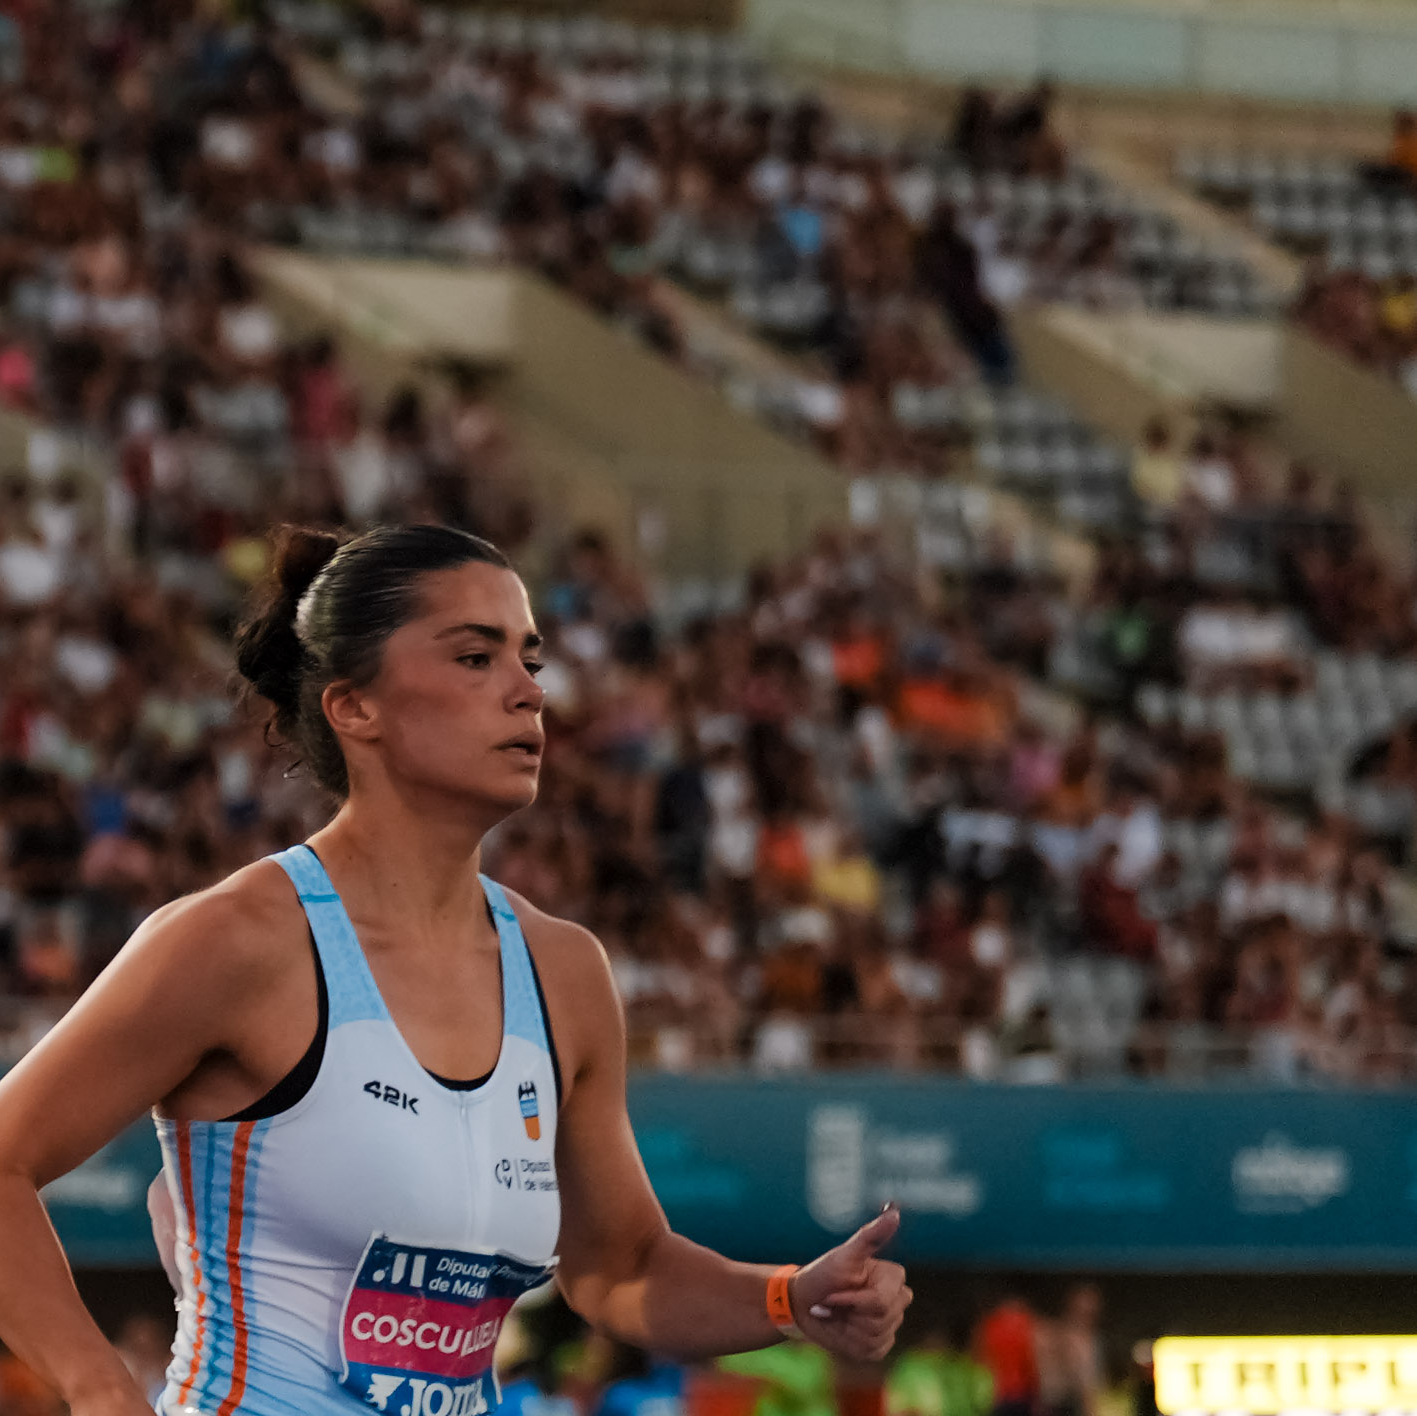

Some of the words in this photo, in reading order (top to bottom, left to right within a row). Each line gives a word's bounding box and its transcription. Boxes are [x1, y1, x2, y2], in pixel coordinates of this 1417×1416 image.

[363, 1080, 420, 1116] 42K
[436, 1257, 493, 1279] Diputa
[428, 1277, 450, 1293] de
[452, 1279, 486, 1299] Mál
